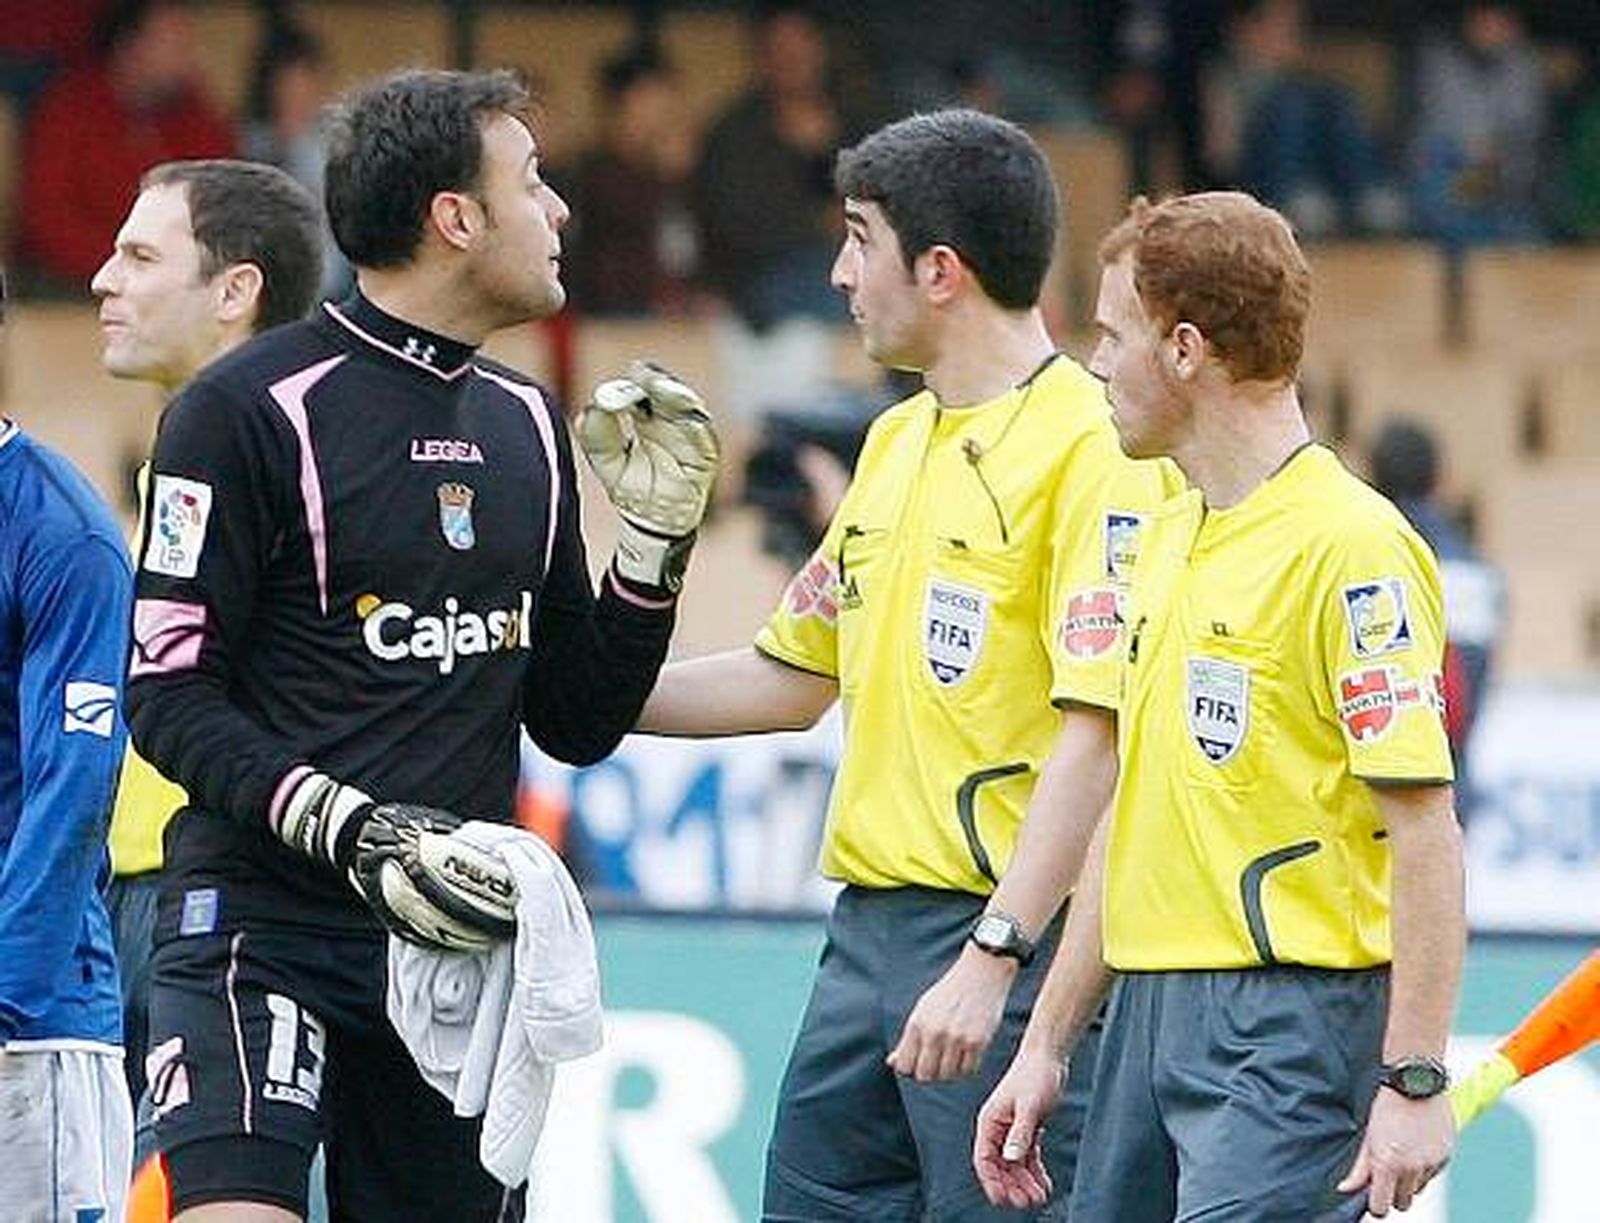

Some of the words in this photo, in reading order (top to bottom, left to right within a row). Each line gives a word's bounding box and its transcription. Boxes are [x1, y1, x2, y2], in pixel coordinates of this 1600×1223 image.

[929, 619, 972, 652] FIFA
[1195, 697, 1237, 725] FIFA
[266, 993, 327, 1099] 13
